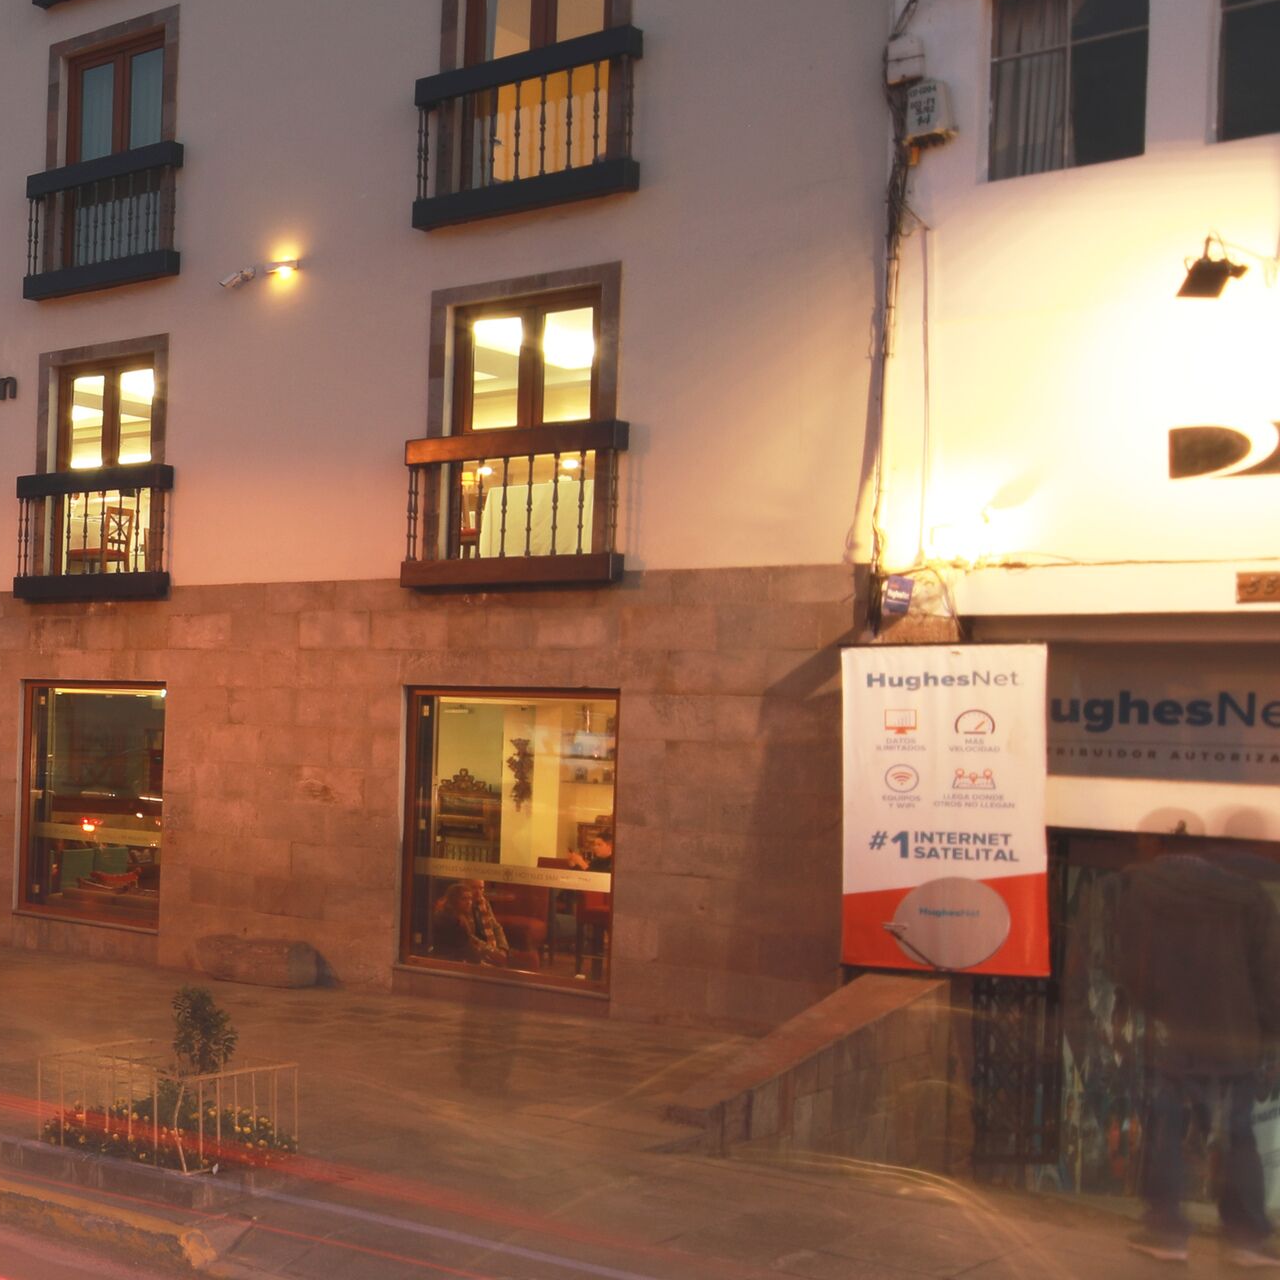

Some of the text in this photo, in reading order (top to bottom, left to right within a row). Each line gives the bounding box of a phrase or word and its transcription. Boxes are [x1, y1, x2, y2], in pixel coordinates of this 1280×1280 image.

[866, 671, 1019, 691] HughesNet
[914, 830, 1012, 846] INTERNET
[914, 846, 1019, 862] SATELITAL
